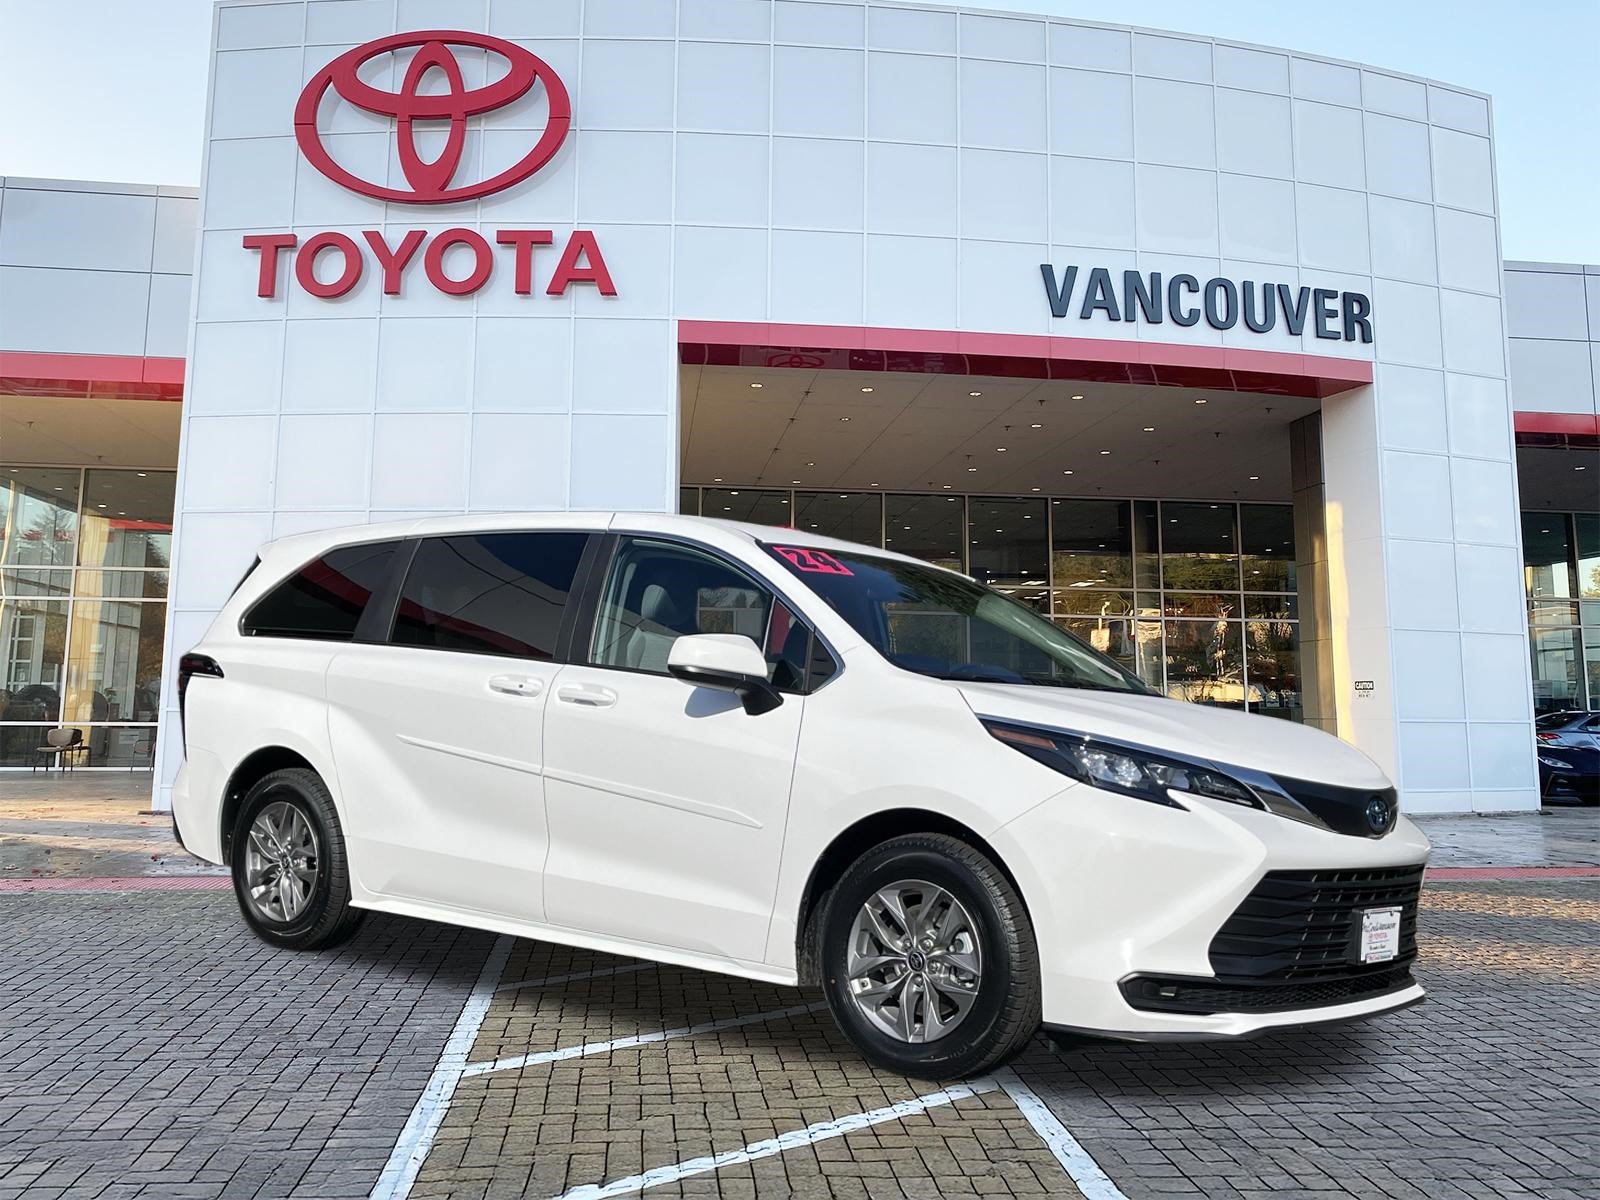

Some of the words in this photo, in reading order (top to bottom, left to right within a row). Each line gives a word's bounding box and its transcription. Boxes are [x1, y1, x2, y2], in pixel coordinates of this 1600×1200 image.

[243, 228, 617, 298] TOYOTA
[1040, 264, 1374, 343] VANCOUVER
[780, 548, 842, 571] 24
